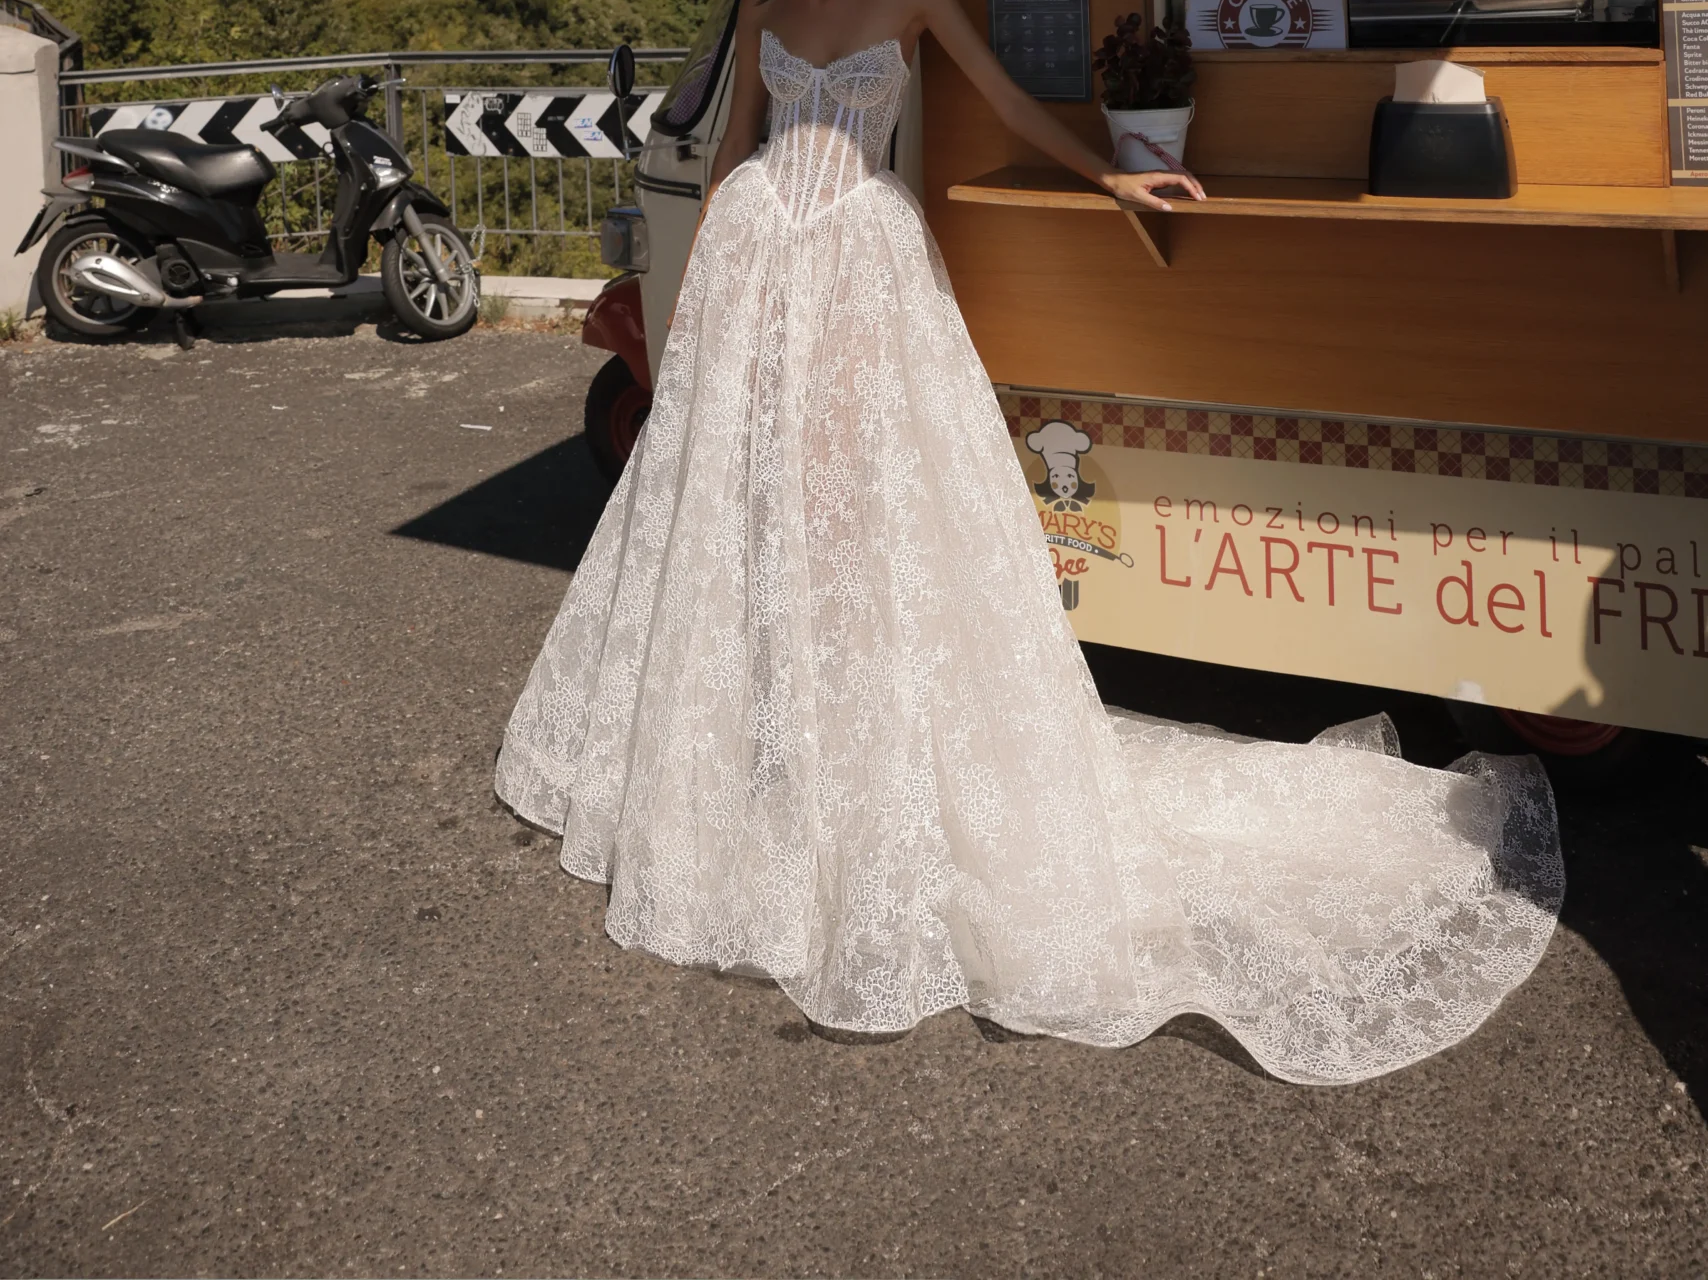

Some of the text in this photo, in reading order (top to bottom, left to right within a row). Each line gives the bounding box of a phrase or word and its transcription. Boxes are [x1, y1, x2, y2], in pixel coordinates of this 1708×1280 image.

[1683, 51, 1702, 59] Sprite
[1067, 538, 1092, 552] FOOD
[1153, 495, 1702, 579] emozioni per il pal
[1155, 524, 1403, 615] L'ARTE
[1436, 559, 1553, 638] del
